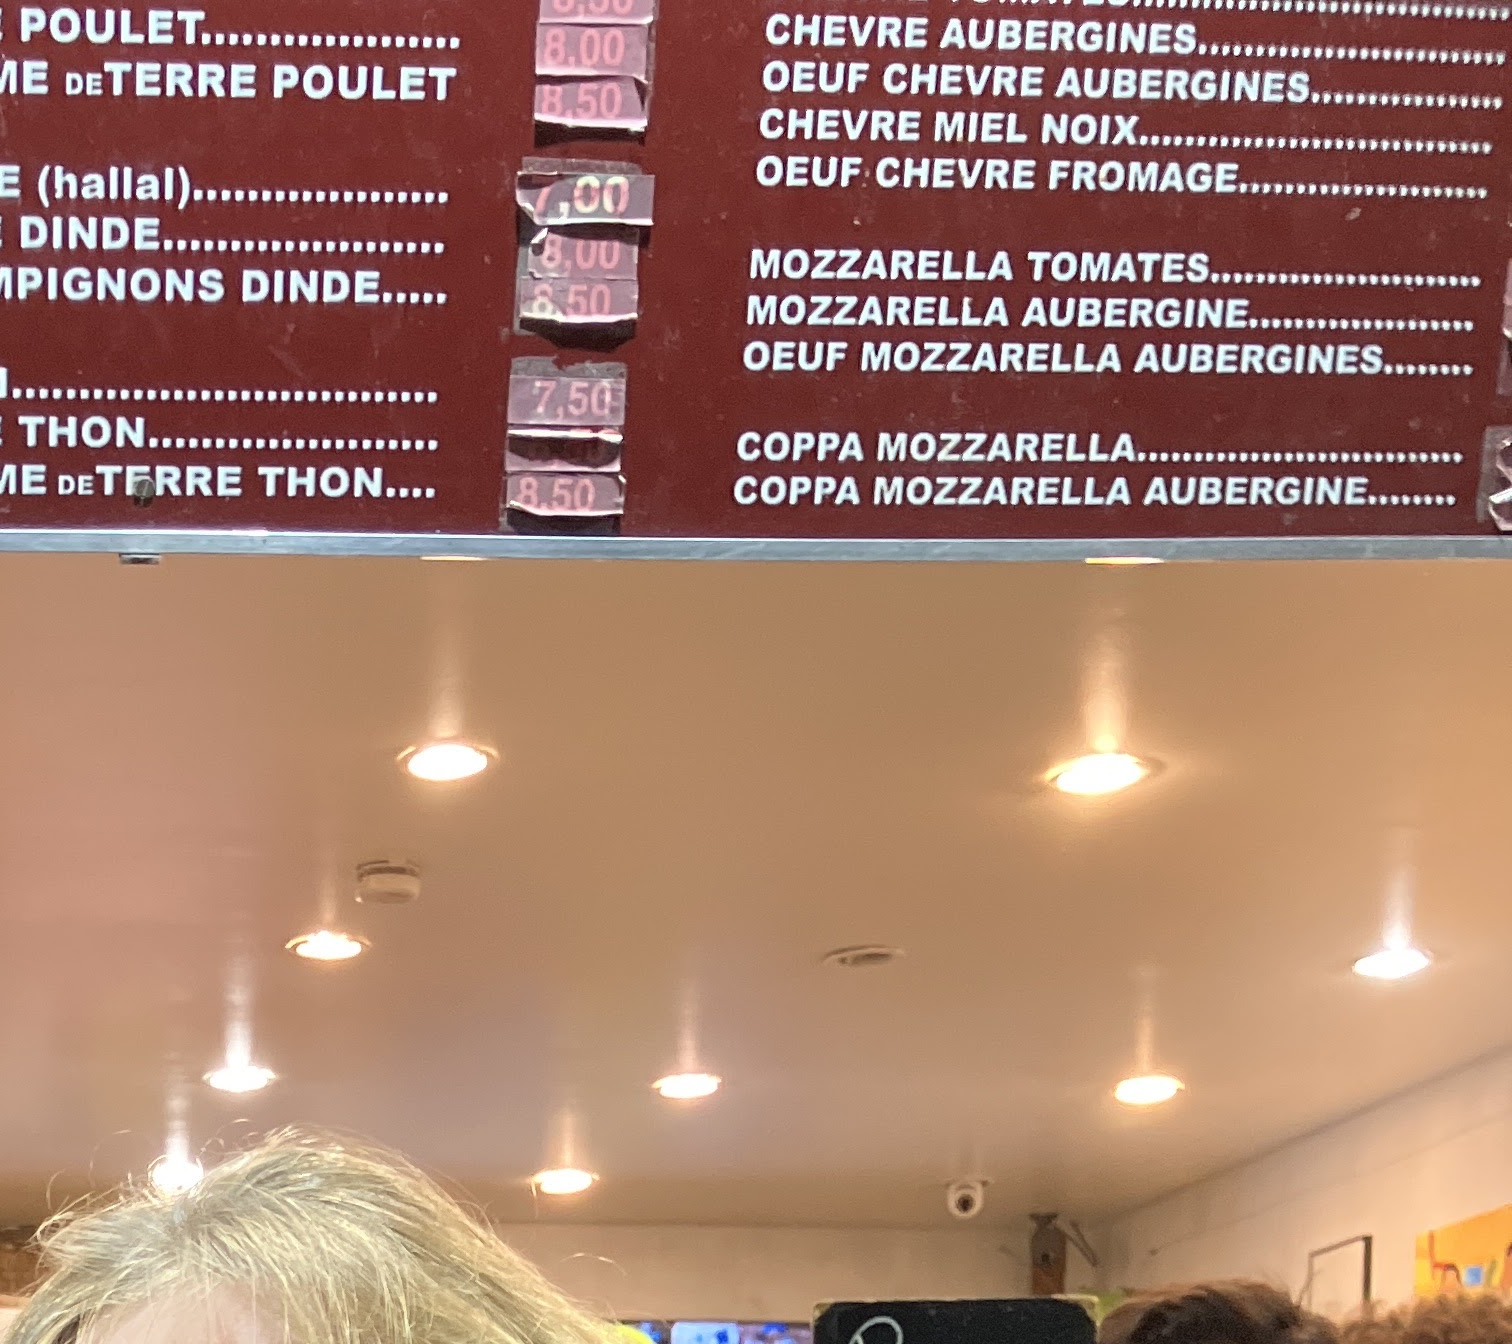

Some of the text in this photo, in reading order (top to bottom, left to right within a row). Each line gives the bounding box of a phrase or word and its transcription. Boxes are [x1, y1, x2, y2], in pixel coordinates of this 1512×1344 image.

[20, 6, 206, 46] POULET
[765, 12, 1197, 55] CHEVRE AUBERGINES
[544, 28, 625, 69] 8,00
[273, 63, 458, 101] POULET
[762, 59, 1310, 104] OEUF CHEVRE AUBERGINES
[759, 107, 1140, 146] CHEVRE MIEL NOIX
[37, 164, 191, 210] (hallal)
[756, 155, 1239, 194] OEUF CHEVRE FROMAGE
[20, 215, 161, 251] DINDE
[749, 248, 1210, 283] MOZZARELLA TOMATES
[241, 269, 381, 304] DINDE
[746, 294, 1250, 329] MOZZARELLA AUBERGINE
[743, 340, 1383, 375] OEUF MOZZARELLA AUBERGINES
[534, 380, 612, 421] 7,50
[17, 415, 145, 448] THON
[736, 431, 1136, 463] COPPA MOZZARELLA
[257, 466, 383, 498] THON
[733, 475, 1369, 506] COPPA MOZZARELLA AUBERGINE
